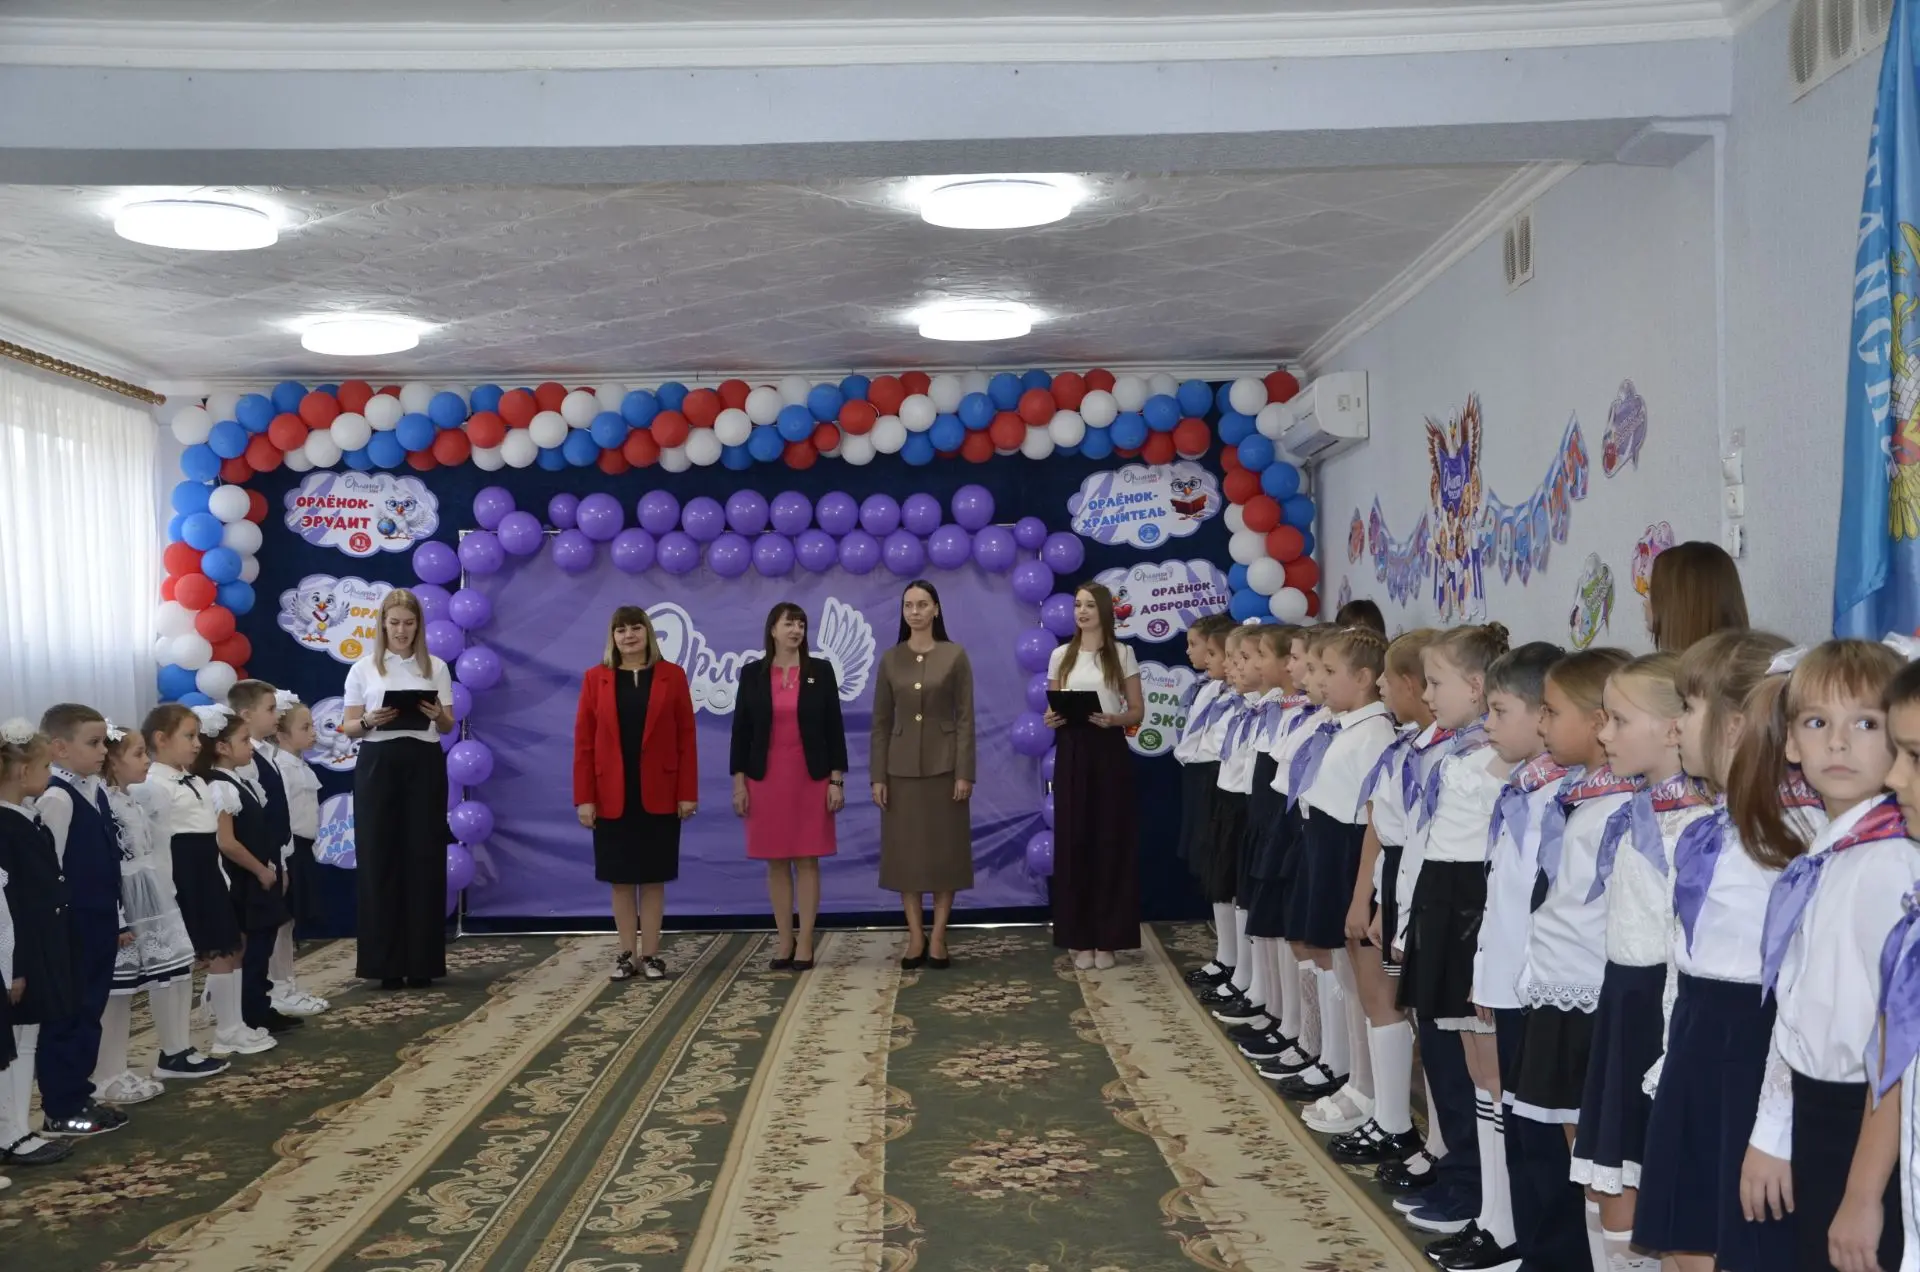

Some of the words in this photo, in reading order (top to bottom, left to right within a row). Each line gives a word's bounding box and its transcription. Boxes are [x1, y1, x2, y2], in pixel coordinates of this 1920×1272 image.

[296, 494, 374, 509] ОРЛЁНОК-
[1088, 491, 1158, 511] ОРЛЁНОК-
[301, 515, 371, 530] ЭРУДИТ
[1082, 507, 1166, 529] ХРАНИТЕЛЬ
[1151, 582, 1216, 597] ОРЛЁНОК-
[1140, 595, 1226, 615] ДОБРОВОЛЕЦ
